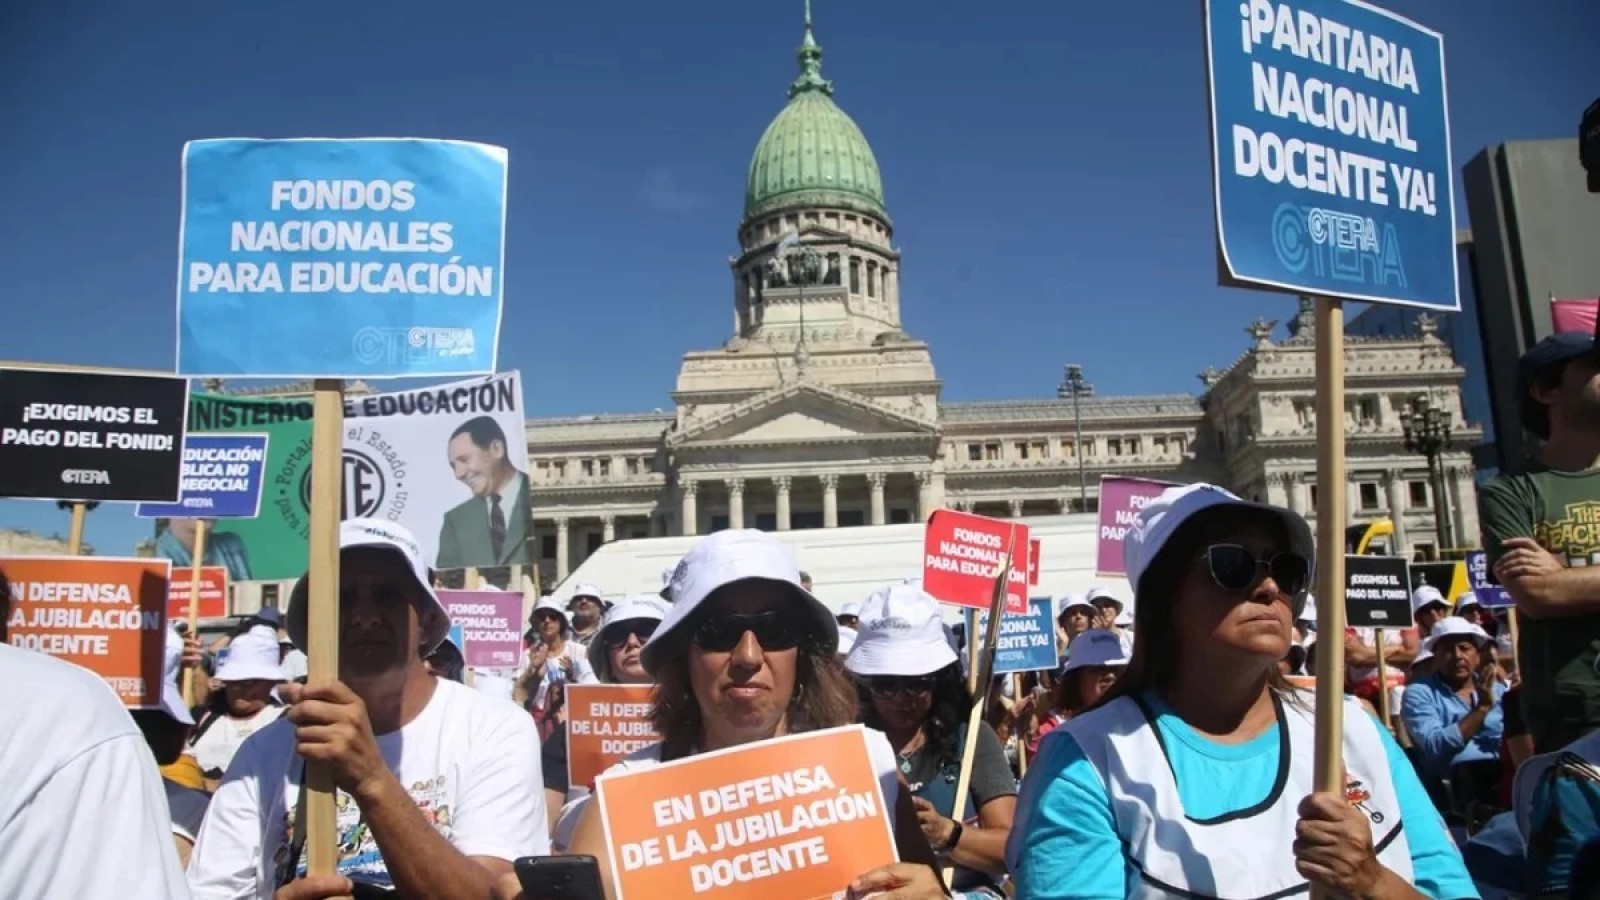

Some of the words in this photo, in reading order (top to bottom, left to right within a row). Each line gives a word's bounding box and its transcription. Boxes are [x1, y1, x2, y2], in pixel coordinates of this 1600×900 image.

[1240, 1, 1420, 95] ¡PARITARIA
[1252, 61, 1418, 153] NACIONAL
[1232, 124, 1389, 206] DOCENTE
[1390, 162, 1437, 216] YA!
[271, 180, 415, 212] FONDOS
[230, 220, 454, 252] NACIONALES
[188, 262, 284, 292] PARA
[290, 256, 493, 297] EDUCACIÓN
[23, 403, 131, 424] ¡EXIGIMOS
[133, 408, 158, 424] EL
[187, 397, 314, 431] INISTERIO
[343, 400, 356, 420] E
[363, 376, 514, 417] EDUCACIÓN
[2, 428, 60, 446] PAGO
[63, 430, 103, 449] DEL
[106, 432, 174, 451] FONID!
[366, 431, 406, 478] Estado
[225, 464, 248, 477] NO
[1572, 506, 1600, 524] THE
[953, 528, 1002, 548] FONDOS
[926, 555, 959, 573] PARA
[1389, 576, 1400, 584] EL
[29, 583, 132, 604] DEFENSA
[1346, 588, 1366, 600] PAGO
[1368, 589, 1382, 600] DEL
[28, 605, 160, 630] JUBILACIÓN
[448, 604, 496, 616] FONDOS
[11, 634, 109, 656] DOCENTE
[1028, 634, 1049, 646] YA!
[590, 702, 614, 716] EN
[572, 722, 592, 734] DE
[594, 722, 612, 736] LA
[652, 794, 694, 828] EN
[699, 766, 835, 817] DEFENSA
[621, 839, 663, 872] DE
[666, 828, 708, 862] LA
[710, 788, 877, 852] JUBILACIÓN
[690, 836, 829, 894] DOCENTE
